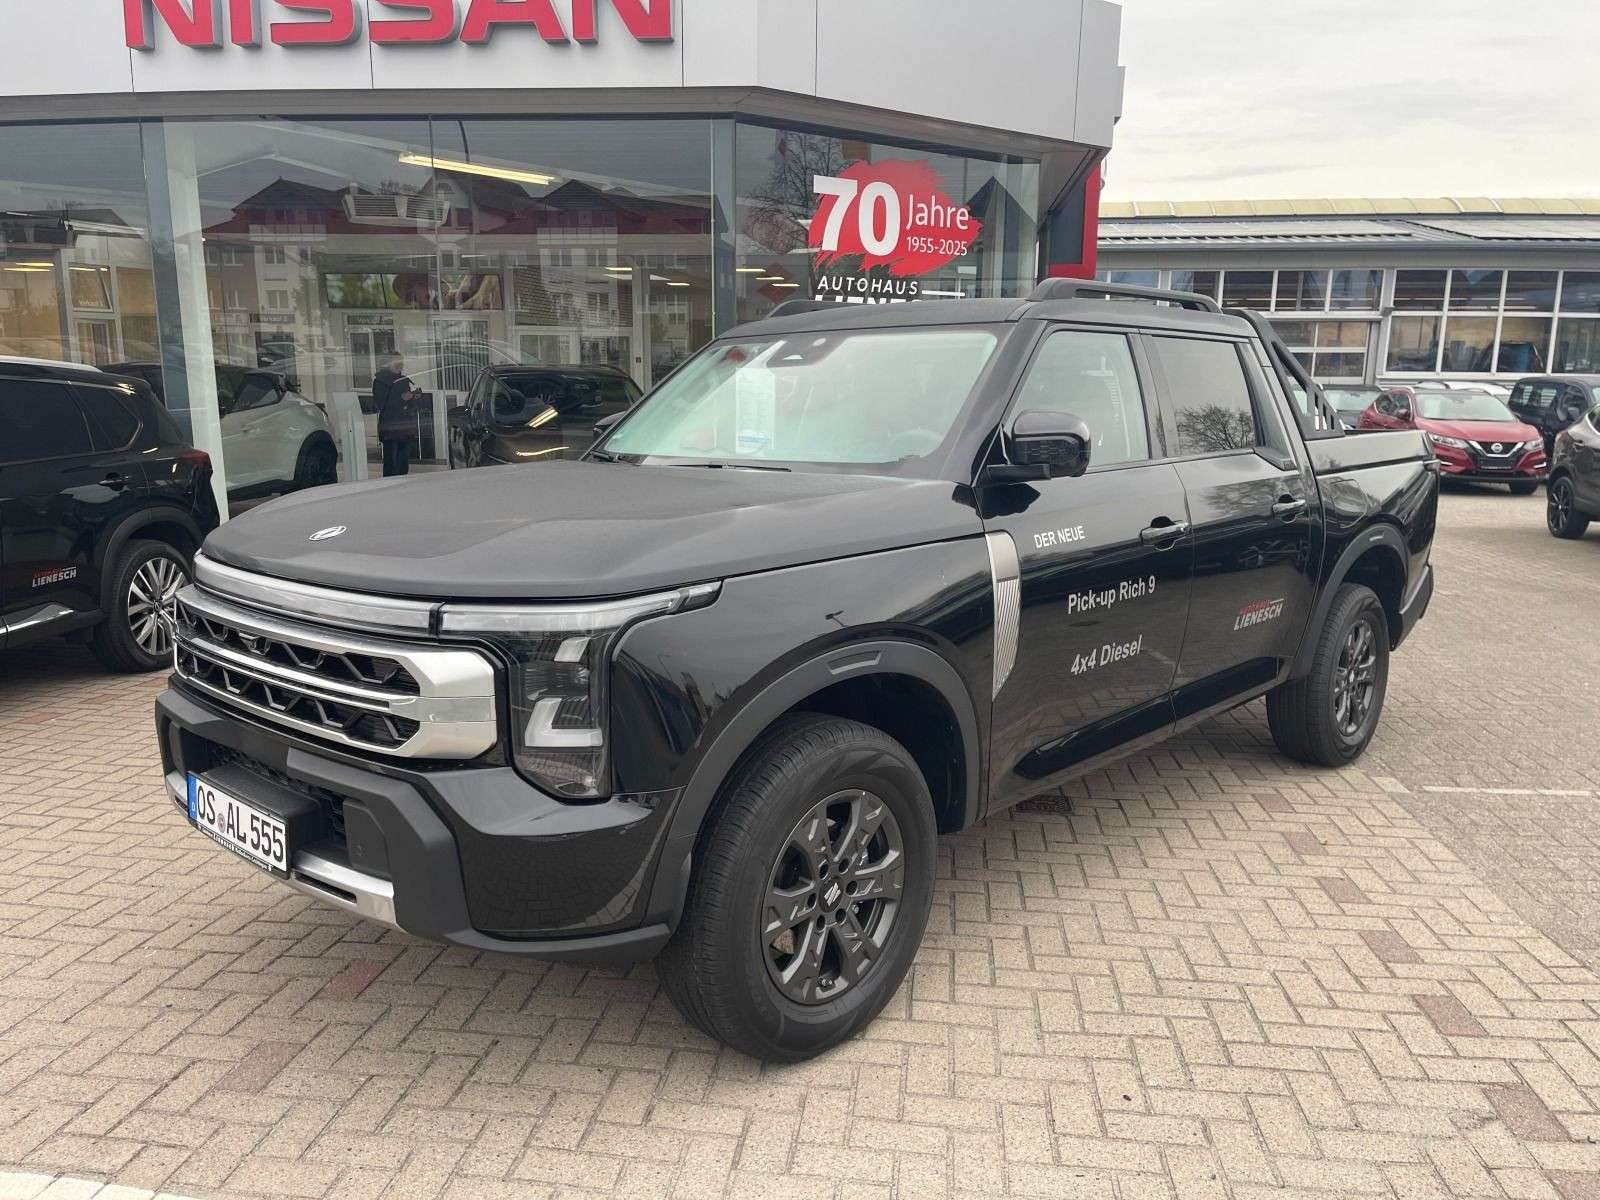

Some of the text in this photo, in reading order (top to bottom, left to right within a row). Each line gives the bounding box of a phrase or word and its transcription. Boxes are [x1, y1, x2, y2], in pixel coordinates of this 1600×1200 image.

[813, 174, 901, 257] 70
[906, 194, 969, 230] Jahre
[906, 236, 968, 256] 1955-2025
[817, 275, 918, 295] AUTOHAUS
[1034, 525, 1086, 548] DER NEUE
[32, 568, 77, 588] LIENESCH
[1068, 575, 1156, 615] Pick-up Rich 9
[1233, 602, 1283, 631] LIENESCH
[1070, 633, 1143, 675] 4x4 Diesel
[197, 785, 216, 825] OS
[226, 801, 247, 844] AL
[250, 813, 284, 862] 555
